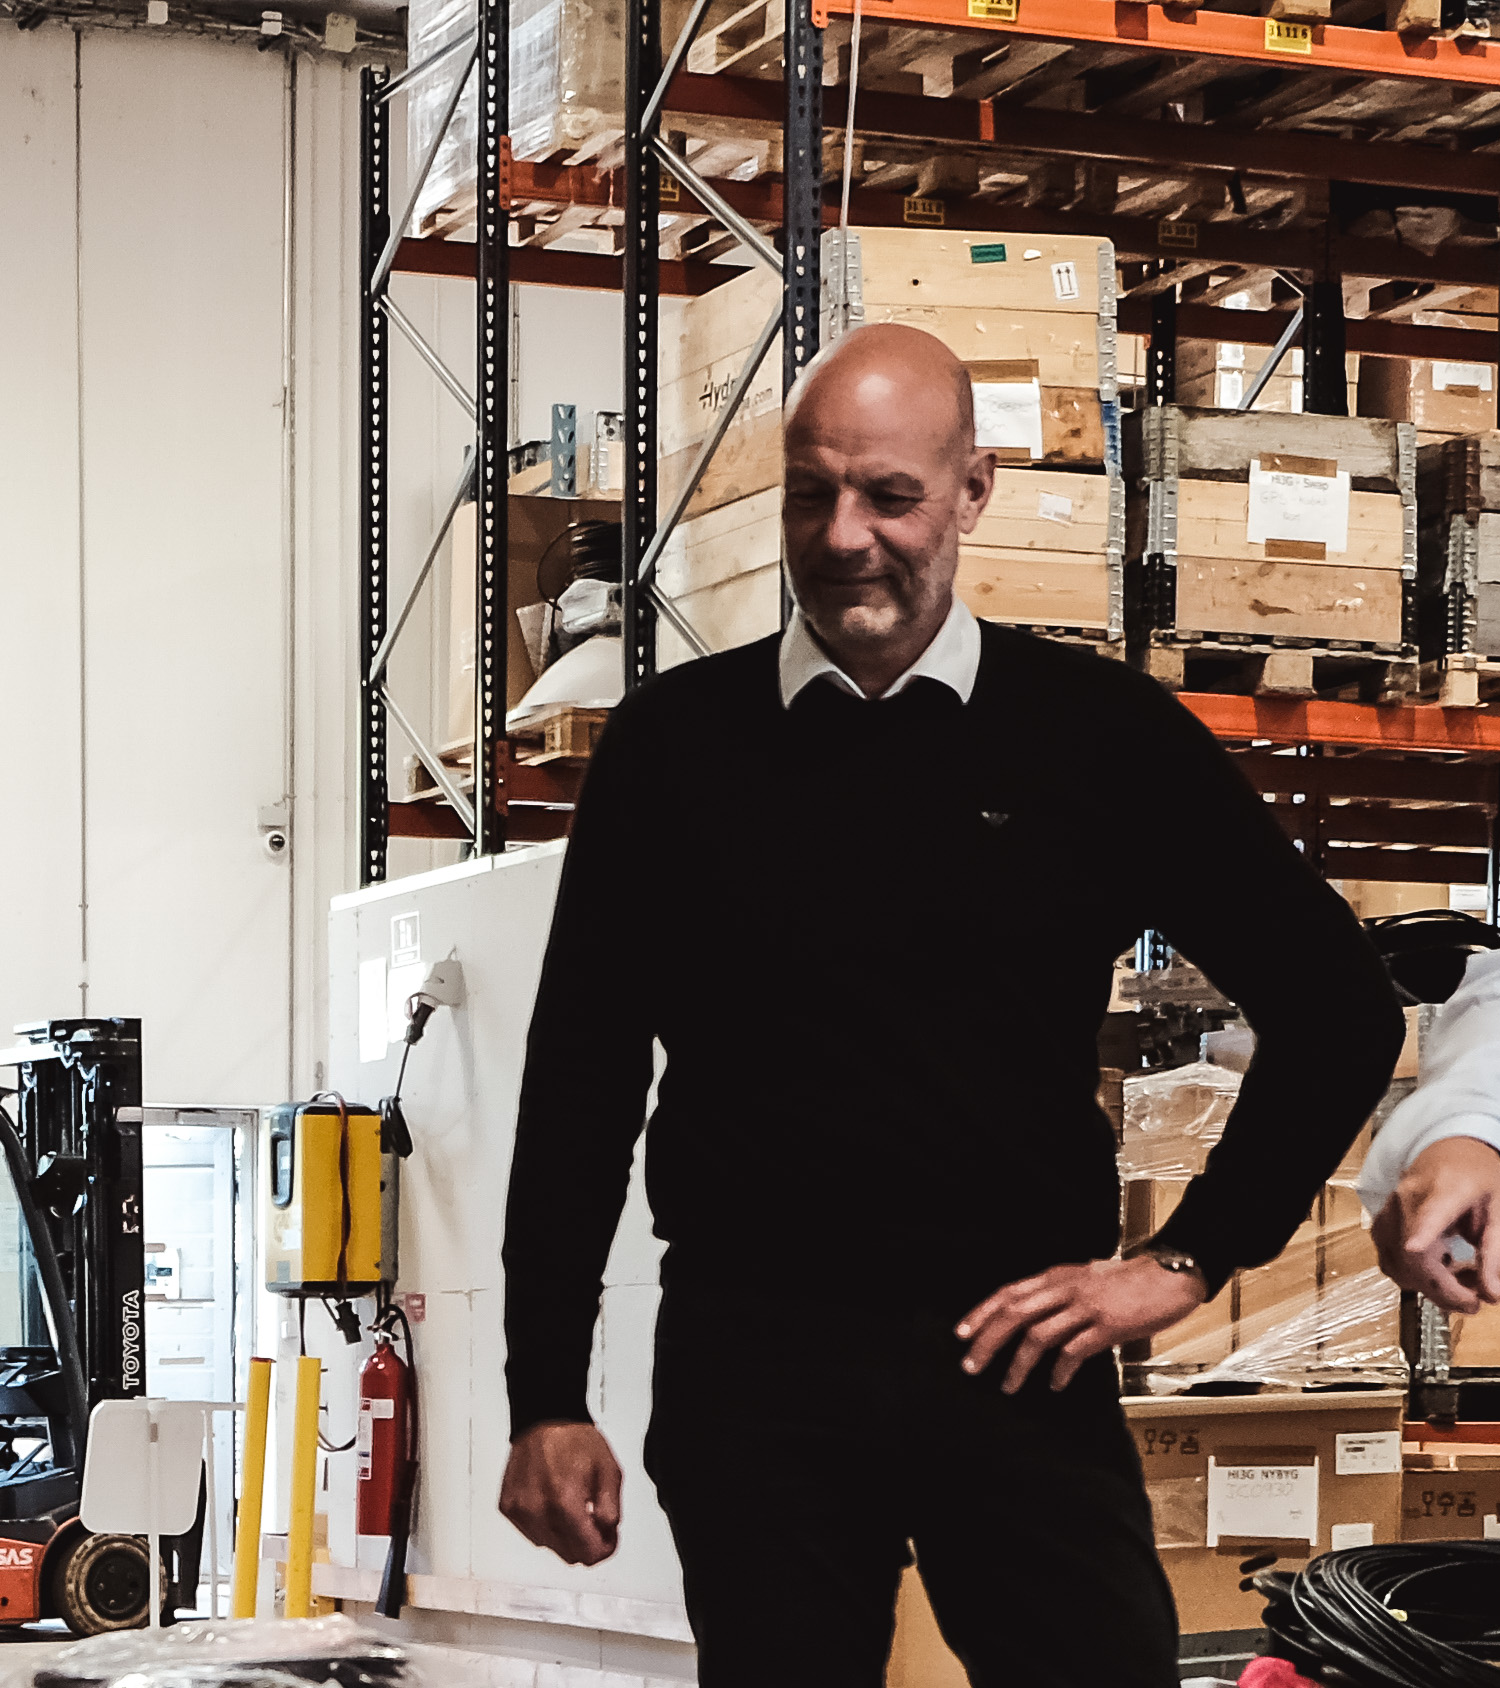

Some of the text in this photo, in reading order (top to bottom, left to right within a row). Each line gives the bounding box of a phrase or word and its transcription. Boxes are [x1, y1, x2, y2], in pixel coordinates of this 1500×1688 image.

[121, 1289, 140, 1390] TOYOTA
[1227, 1469, 1299, 1480] HI3G NYBYG
